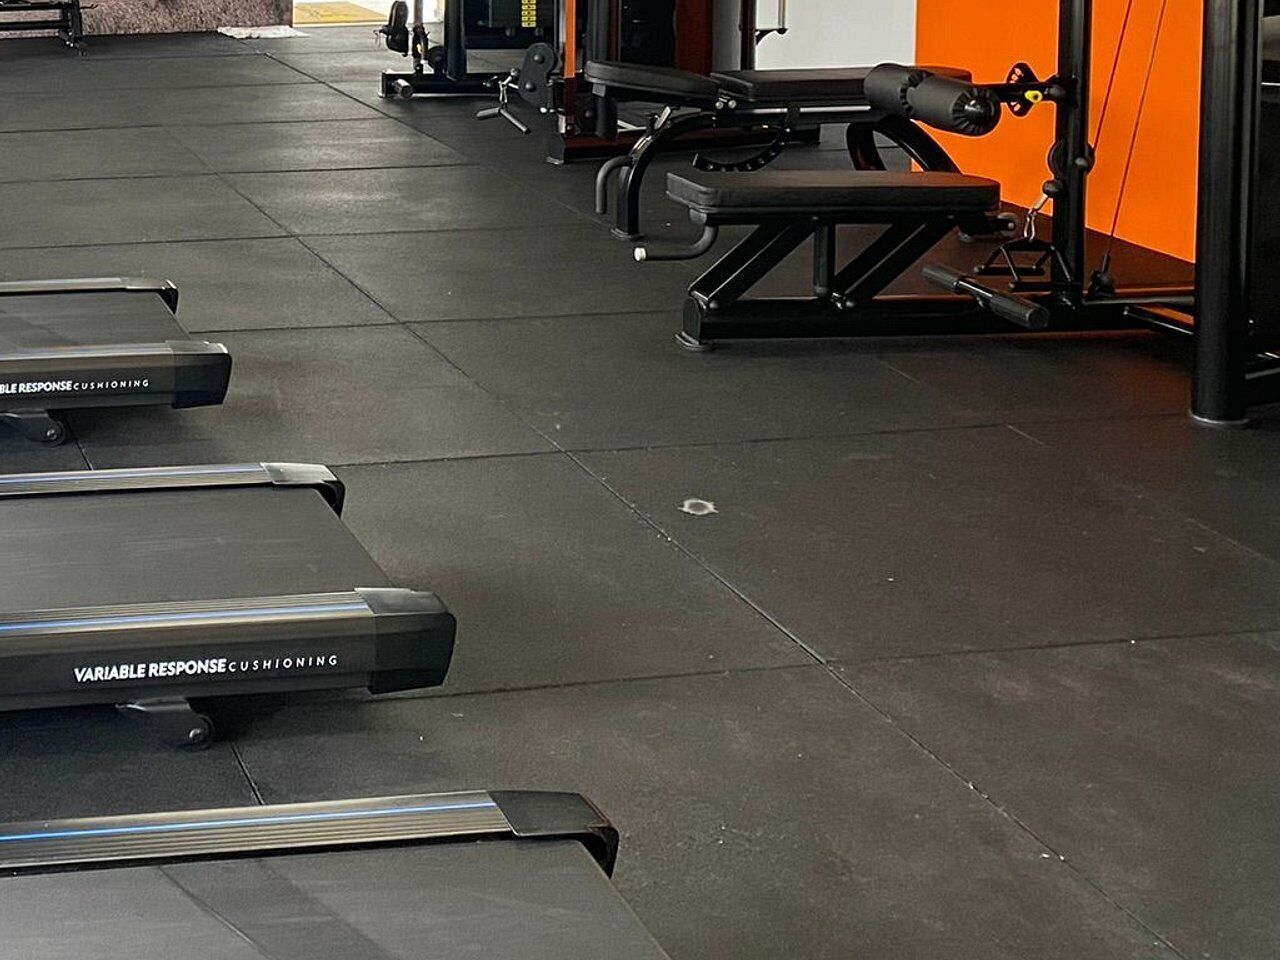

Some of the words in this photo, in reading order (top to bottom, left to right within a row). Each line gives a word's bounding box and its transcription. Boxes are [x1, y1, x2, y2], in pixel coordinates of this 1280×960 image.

[18, 381, 72, 393] RESPONSE
[73, 379, 149, 391] CUSHIONING
[73, 663, 146, 683] VARIABLE
[148, 658, 227, 678] RESPONSE
[228, 655, 338, 673] CUSHIONING
